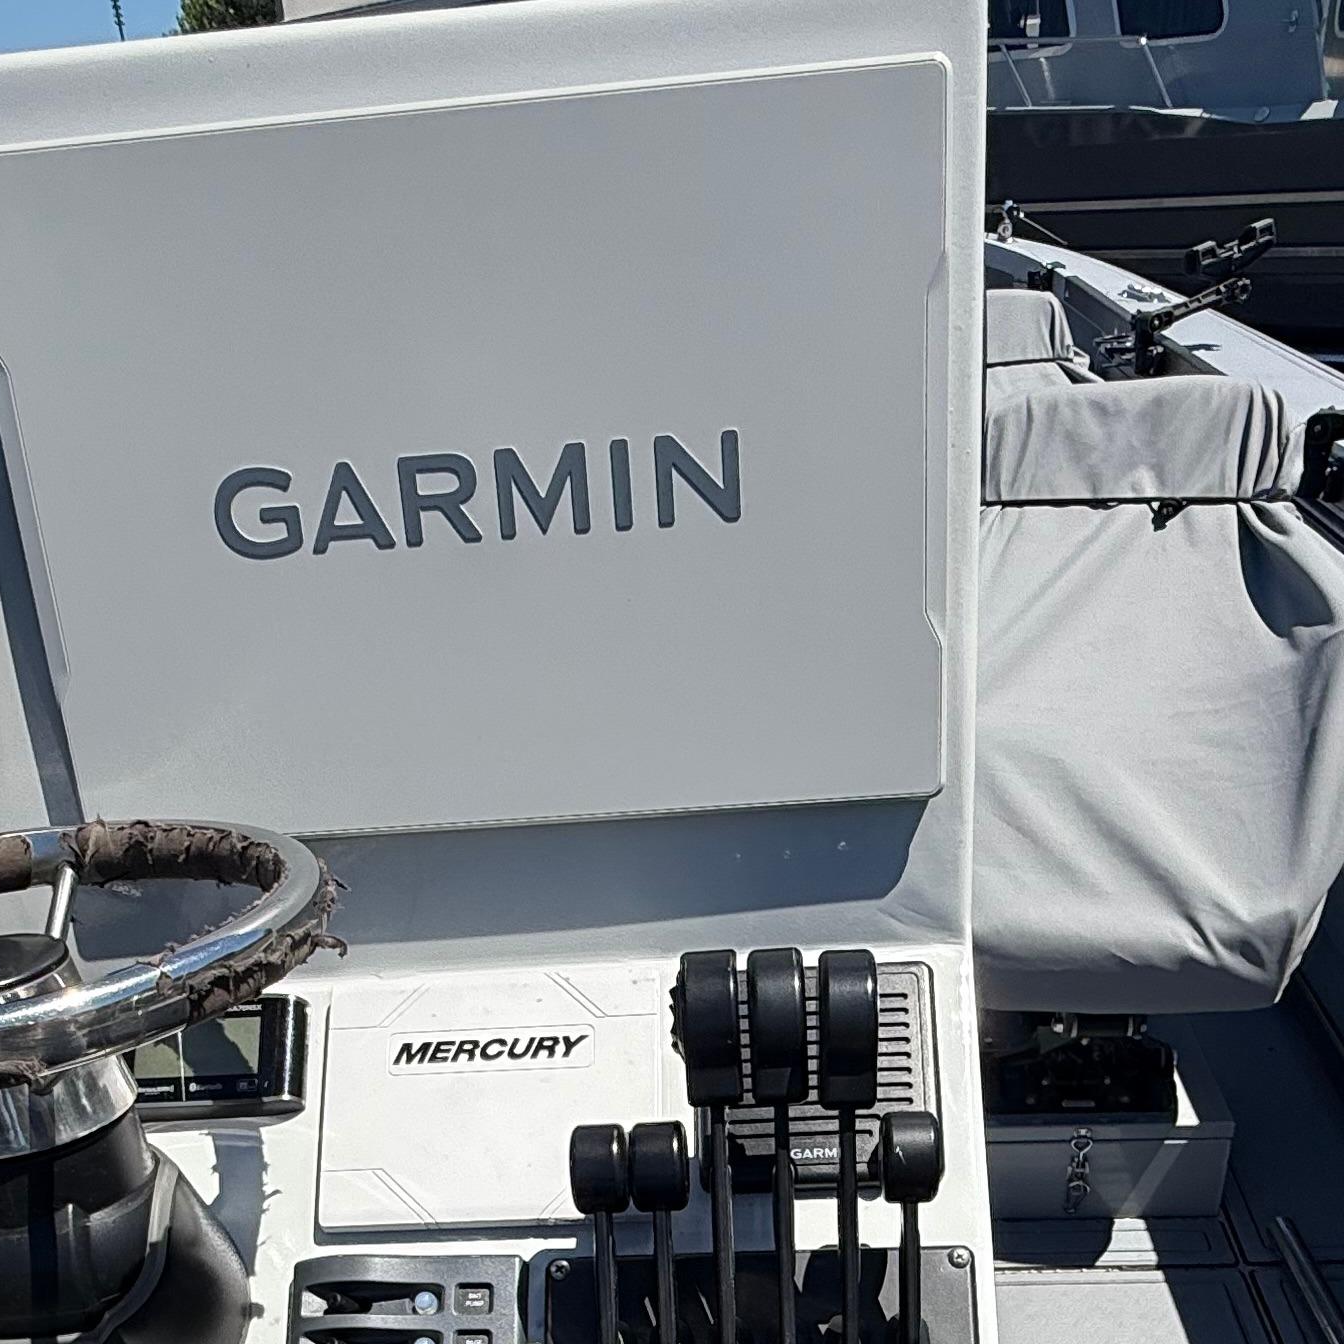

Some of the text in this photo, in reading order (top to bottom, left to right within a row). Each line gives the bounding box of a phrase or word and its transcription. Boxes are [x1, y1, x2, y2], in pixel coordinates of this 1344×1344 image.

[213, 428, 743, 561] GARMIN
[392, 1033, 590, 1067] MERCURY
[790, 1147, 838, 1159] GARM
